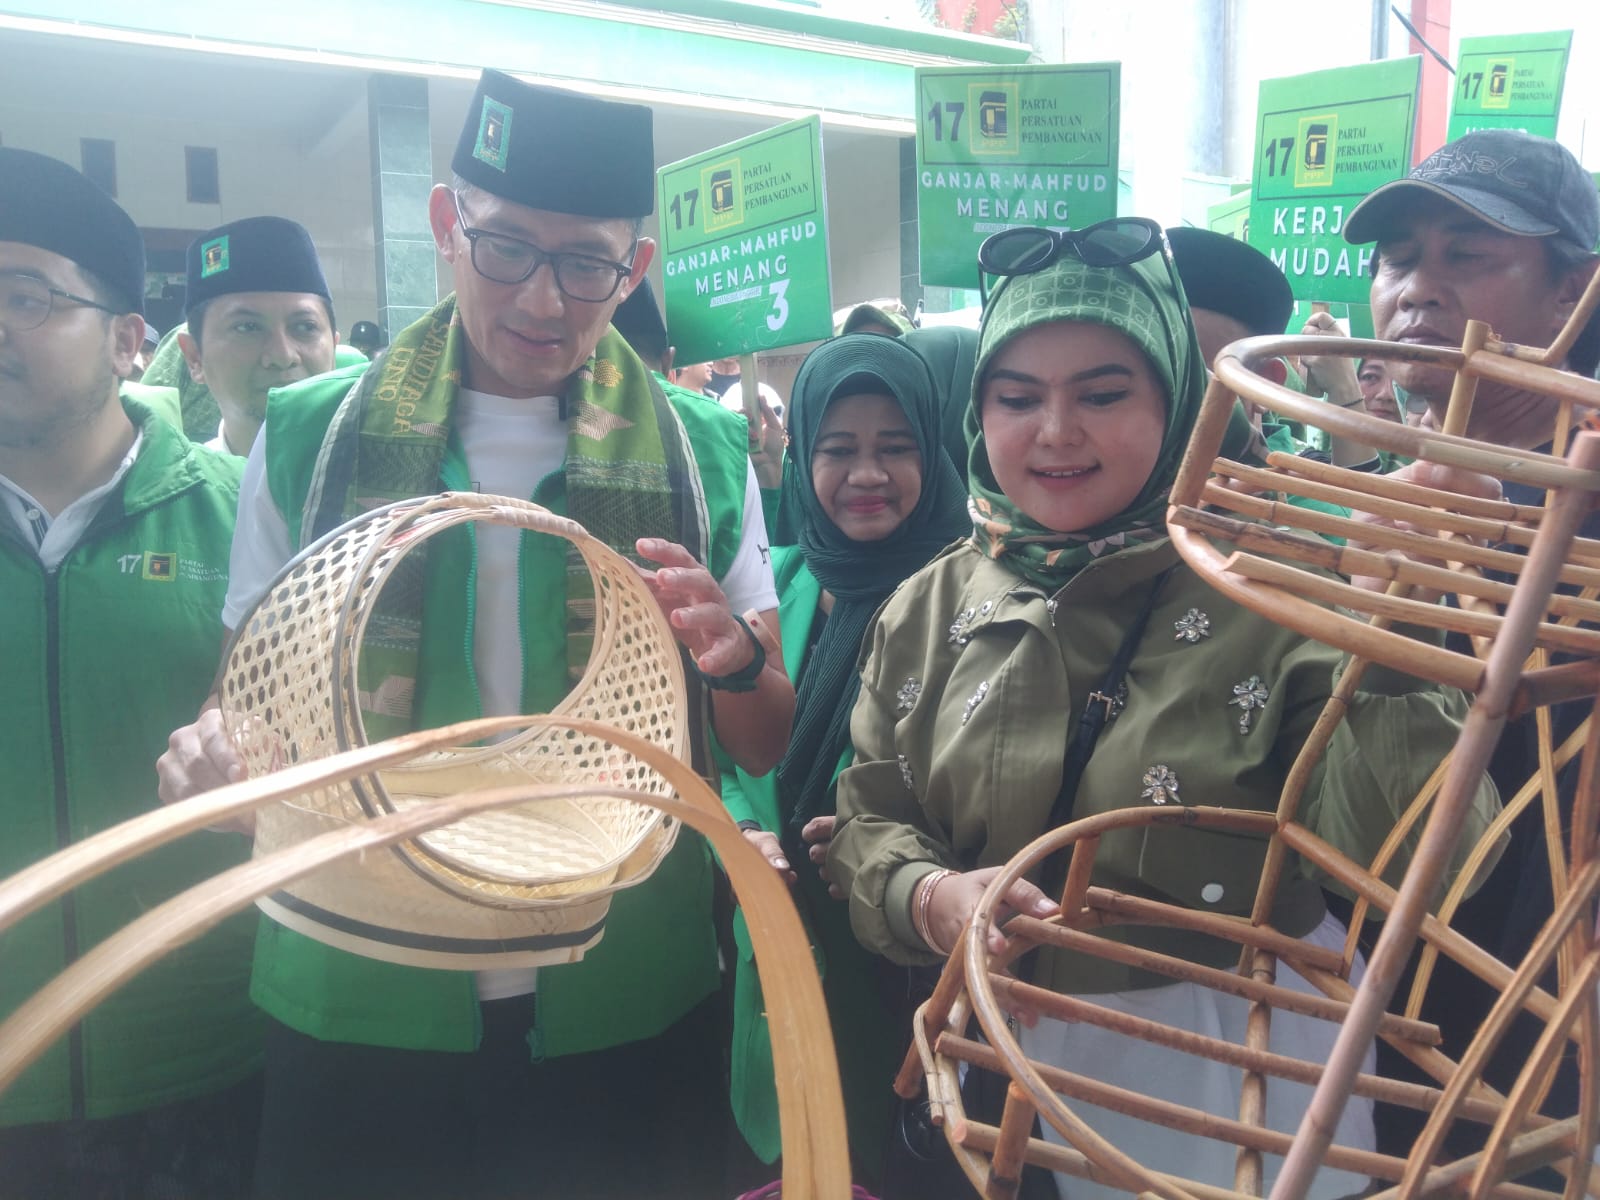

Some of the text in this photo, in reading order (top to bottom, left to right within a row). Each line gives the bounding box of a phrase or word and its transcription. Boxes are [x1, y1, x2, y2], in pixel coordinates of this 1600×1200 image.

[1463, 72, 1484, 100] 17
[1021, 98, 1057, 111] PARTAI
[928, 101, 965, 141] 17
[1021, 115, 1082, 128] PERSATUAN
[1337, 127, 1367, 140] PARTAI
[1021, 131, 1102, 144] PEMBANGUNAN
[1336, 143, 1384, 157] PERSATUAN
[1265, 137, 1295, 177] 17
[1335, 159, 1398, 173] PEMBANGUNAN
[743, 162, 772, 180] PARTAI
[744, 172, 792, 195] PERSATUAN
[922, 171, 1107, 192] GANJAR-MAHFUD
[670, 188, 700, 230] 17
[744, 182, 809, 211] PEMBANGUNAN
[957, 198, 1068, 220] MENANG
[1273, 205, 1344, 236] KERJ
[666, 221, 817, 276] GANJAR-MAHFUD
[1270, 247, 1375, 277] MUDAH
[695, 255, 788, 296] MENANG
[766, 279, 791, 331] 3
[379, 347, 415, 401] UNO
[117, 554, 142, 573] 17
